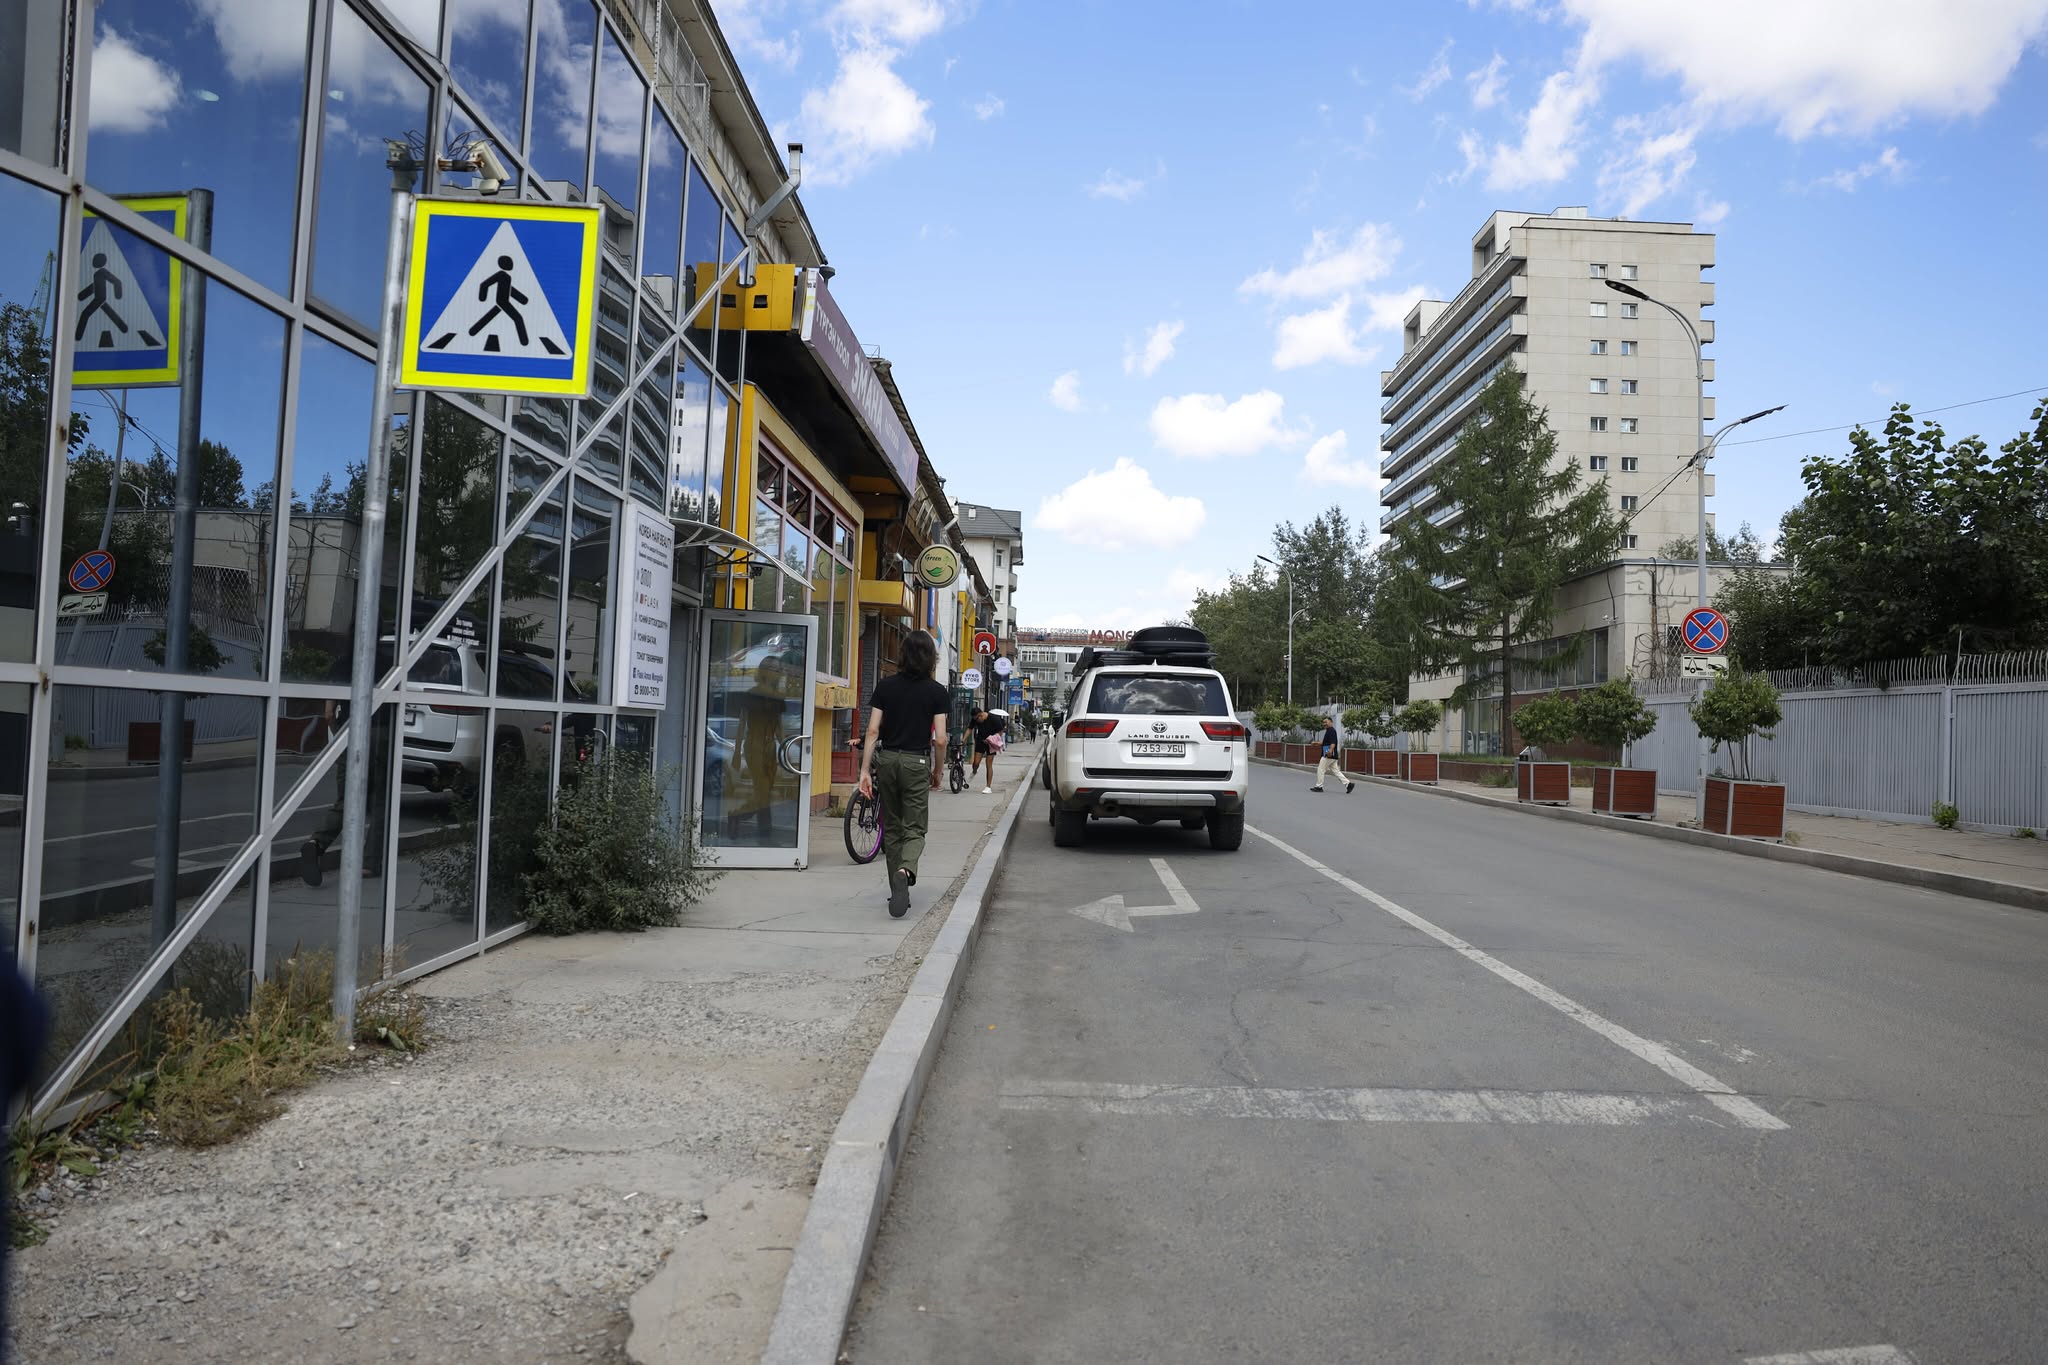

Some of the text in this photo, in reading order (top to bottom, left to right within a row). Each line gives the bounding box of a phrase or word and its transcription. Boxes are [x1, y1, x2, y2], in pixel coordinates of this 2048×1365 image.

[851, 352, 883, 434] ЭМАНА
[639, 524, 652, 539] KOREA
[924, 553, 942, 562] Green
[1167, 743, 1184, 753] УБЦ
